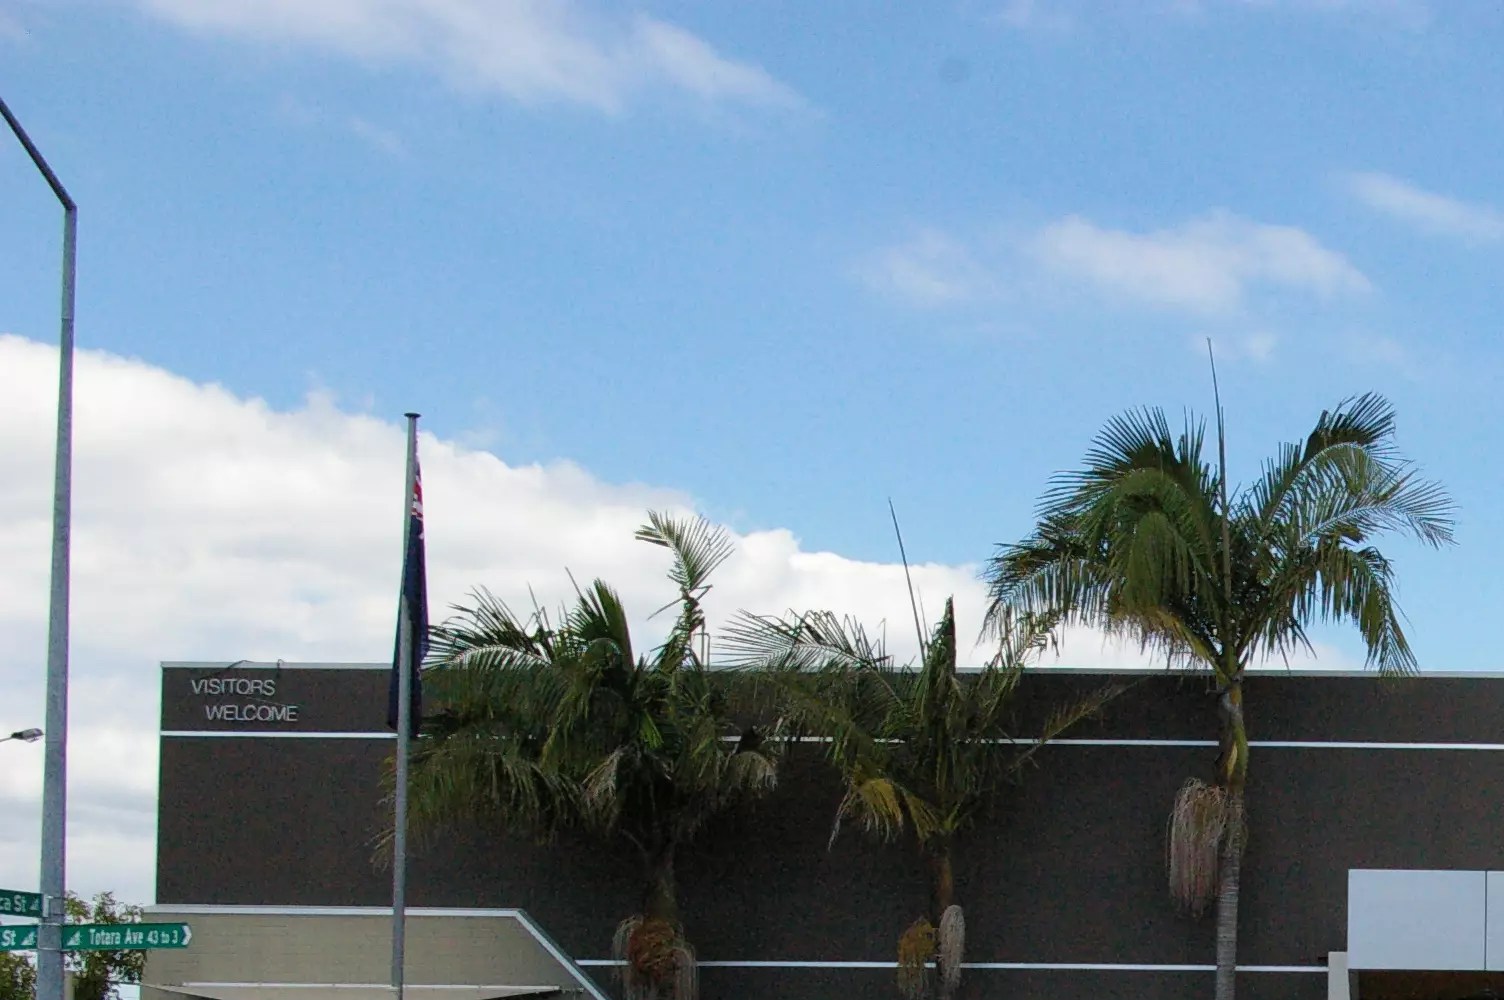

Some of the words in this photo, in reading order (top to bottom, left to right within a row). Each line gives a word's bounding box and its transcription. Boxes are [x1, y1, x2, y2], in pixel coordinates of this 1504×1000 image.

[191, 679, 276, 696] VISITORS
[206, 704, 298, 722] WELCOME
[14, 894, 27, 912] St
[1, 929, 16, 947] St
[89, 928, 121, 946] Totara
[124, 928, 144, 945] Ave
[172, 929, 178, 944] 3
